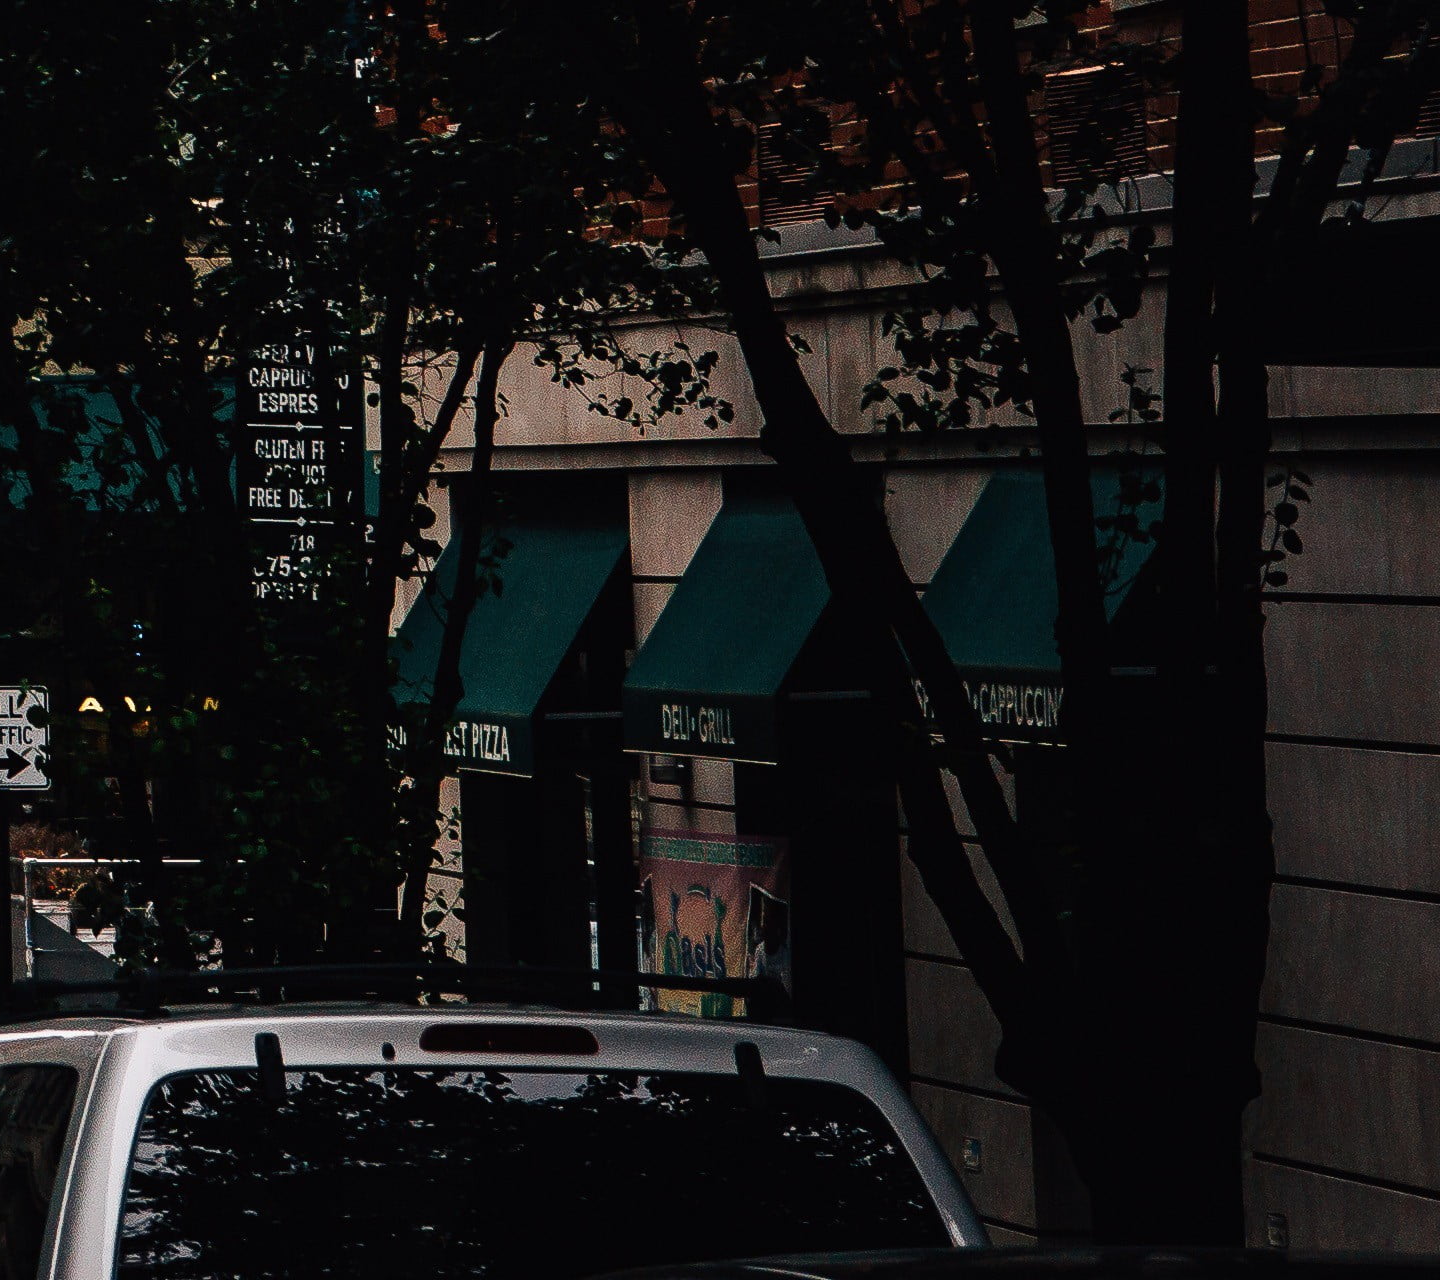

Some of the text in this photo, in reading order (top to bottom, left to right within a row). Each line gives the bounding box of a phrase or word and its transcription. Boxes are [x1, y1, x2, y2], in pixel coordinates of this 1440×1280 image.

[660, 703, 735, 745] DELI GRILL
[980, 682, 1065, 728] CAPPUCCIN
[472, 722, 511, 762] PIZZA
